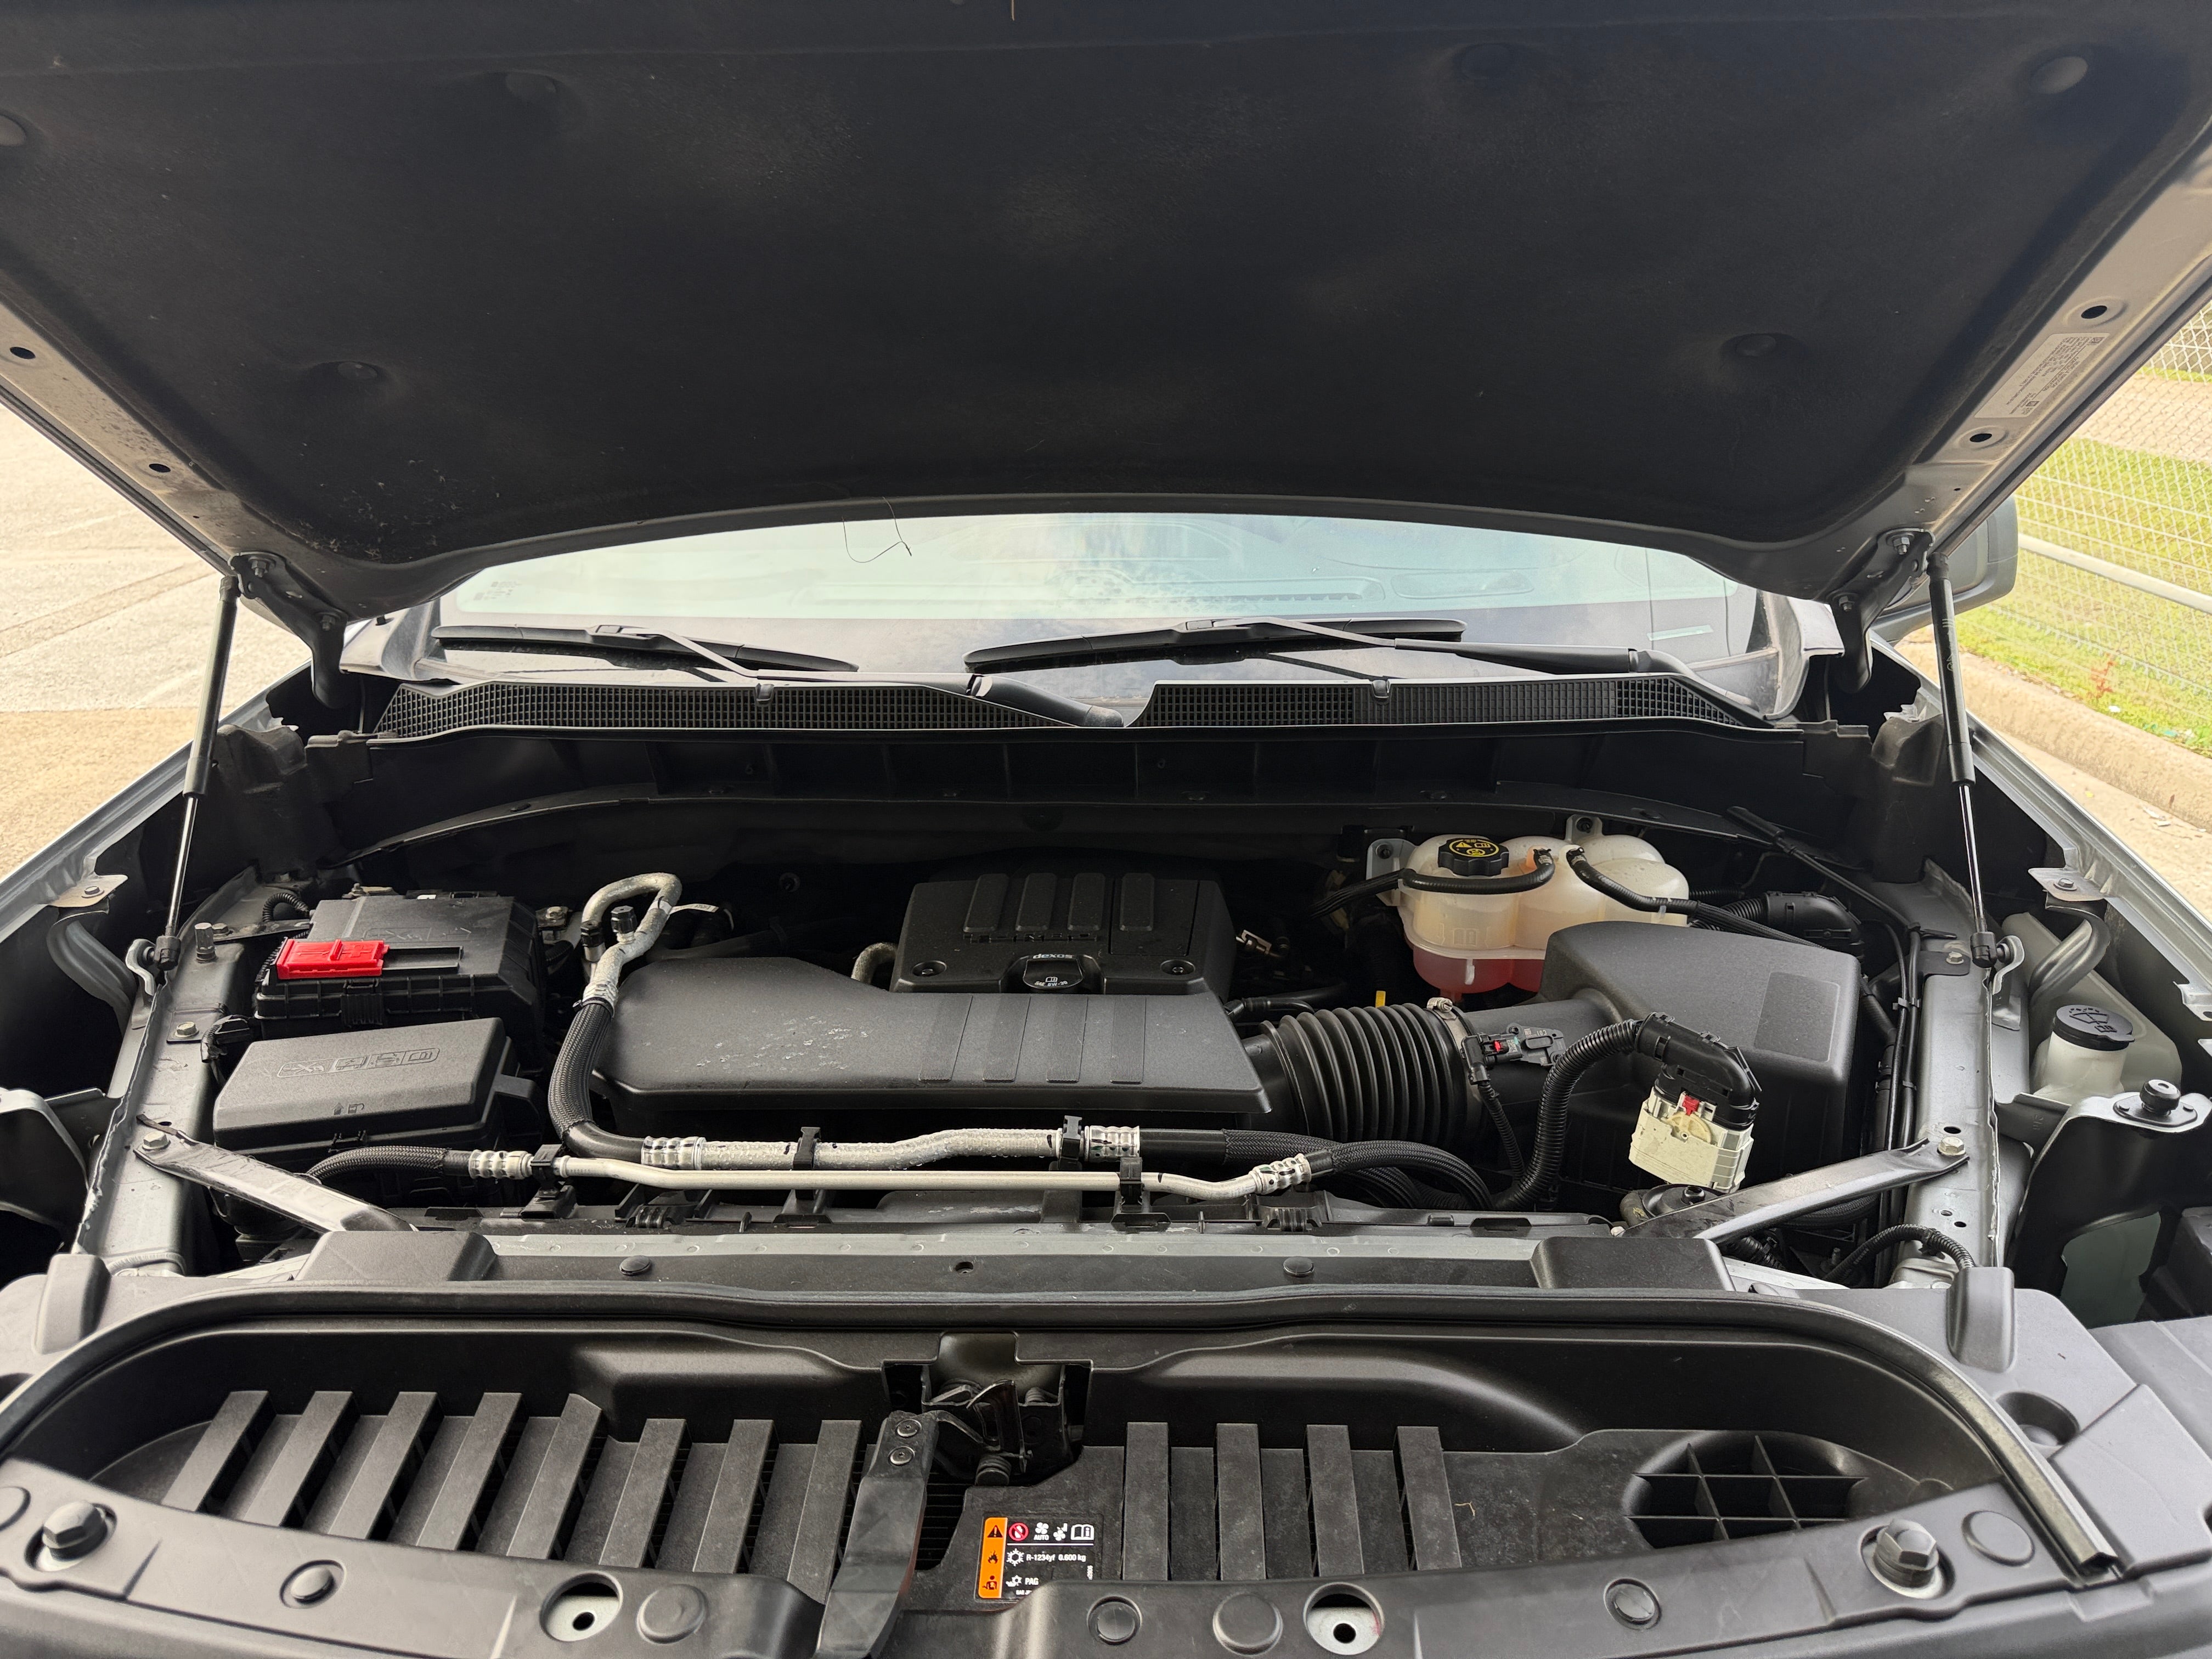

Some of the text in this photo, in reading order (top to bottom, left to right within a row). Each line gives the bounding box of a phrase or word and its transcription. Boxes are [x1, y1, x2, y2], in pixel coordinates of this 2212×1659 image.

[1026, 1554, 1056, 1562] R-1234yf
[1077, 1554, 1086, 1562] kg
[1025, 1577, 1039, 1585] PAG
